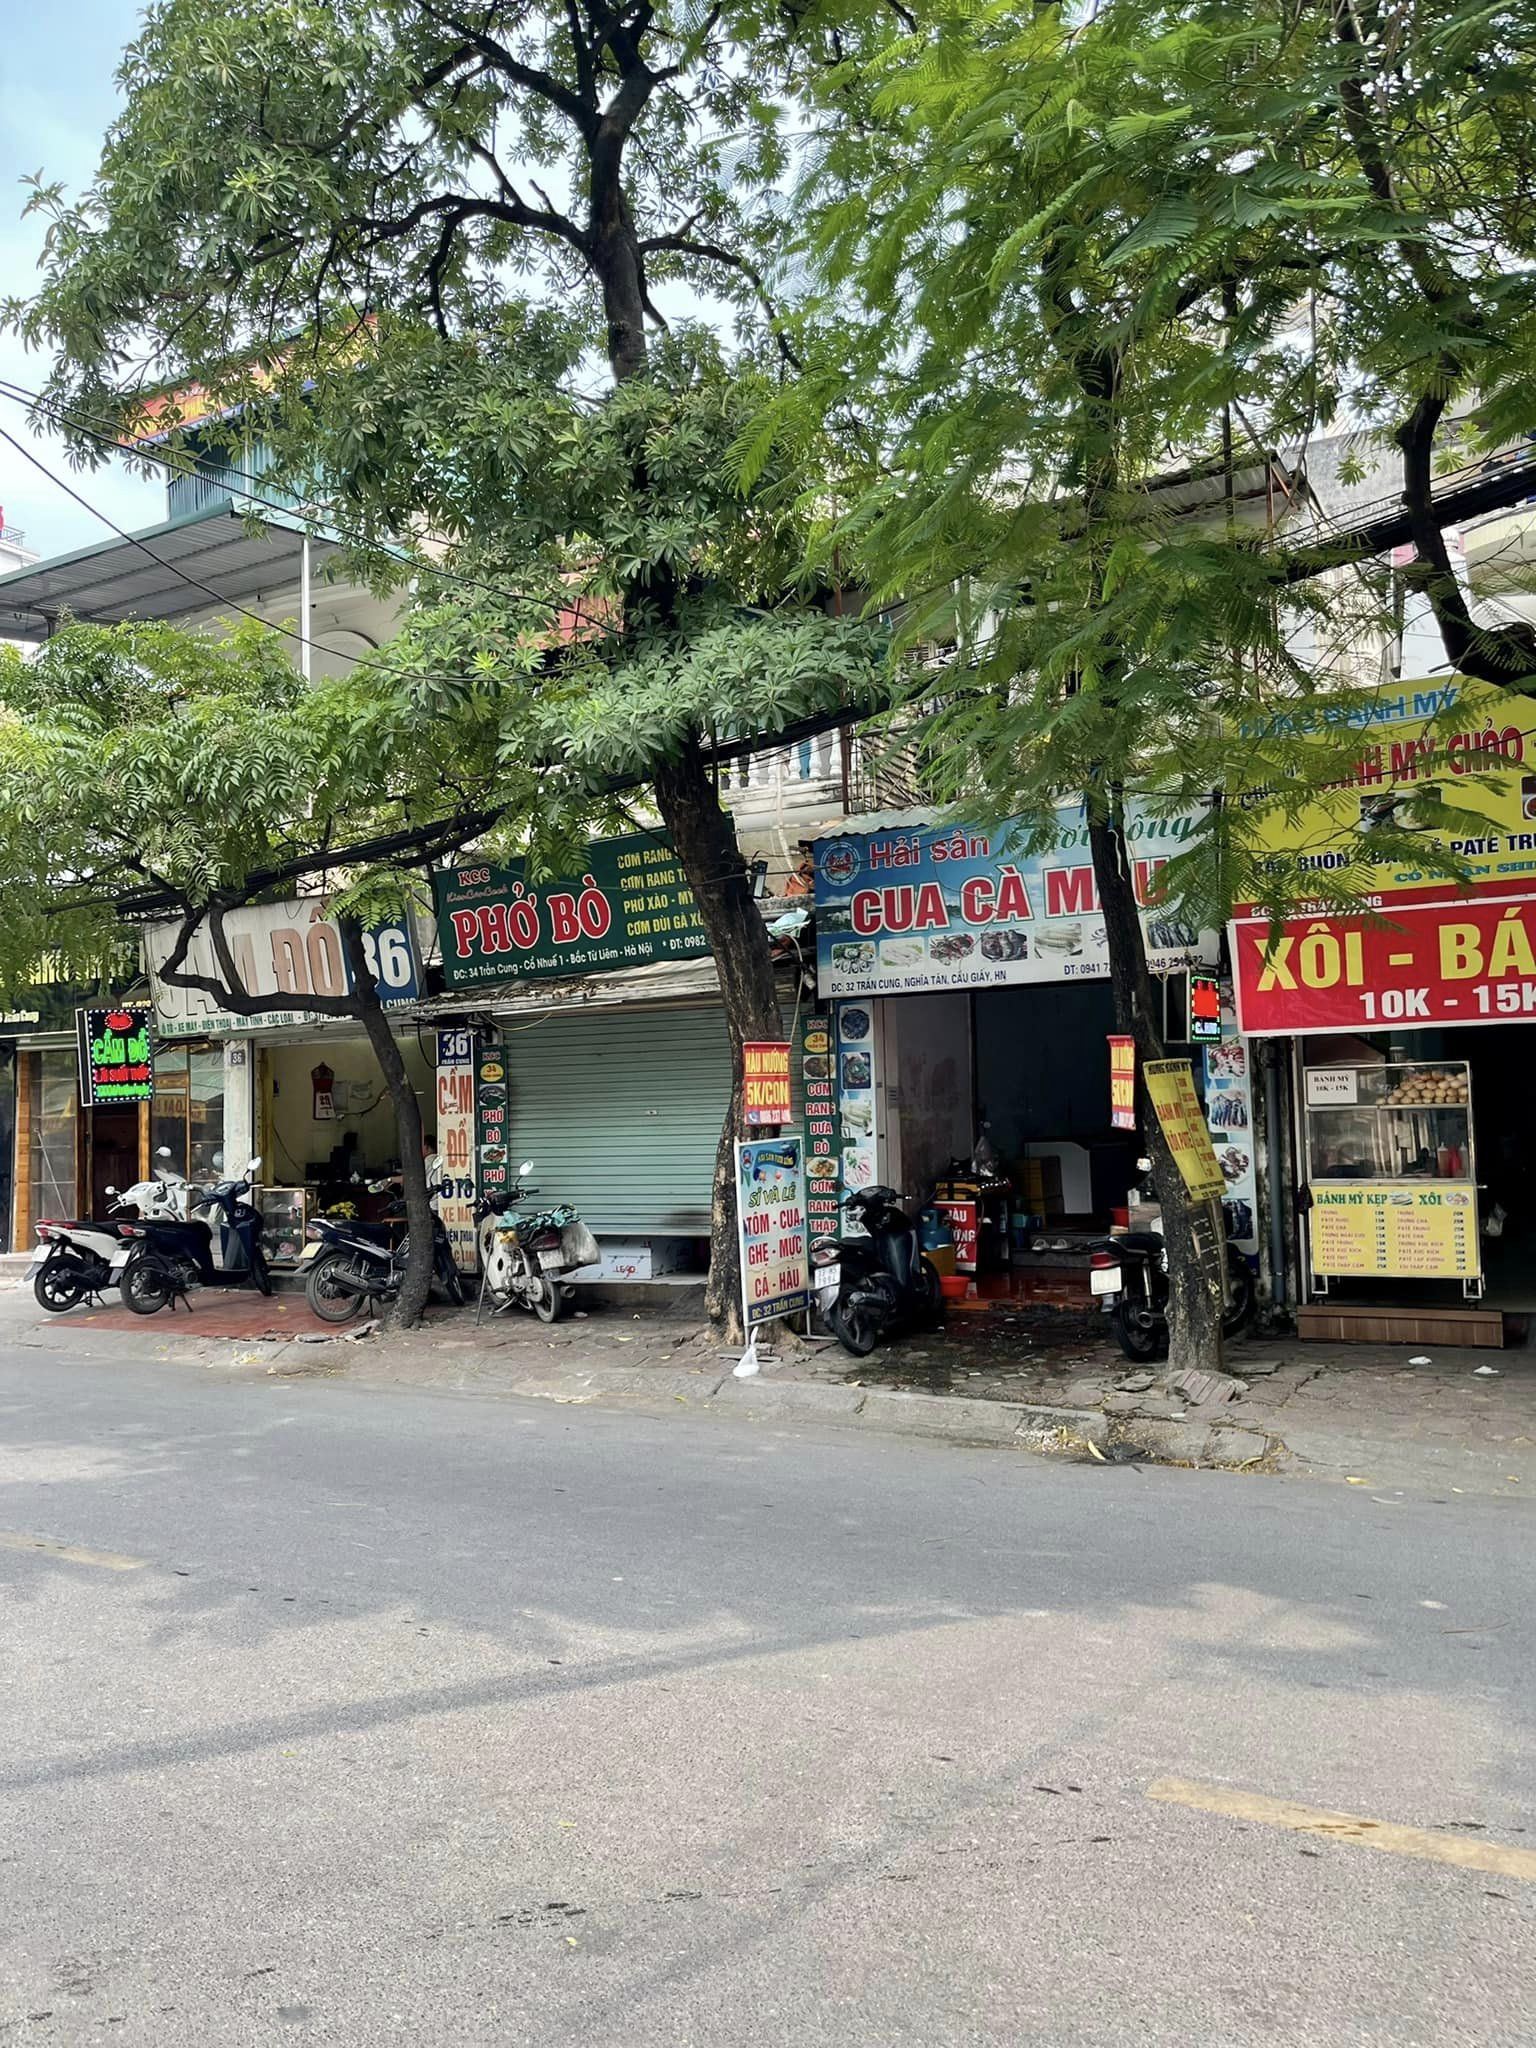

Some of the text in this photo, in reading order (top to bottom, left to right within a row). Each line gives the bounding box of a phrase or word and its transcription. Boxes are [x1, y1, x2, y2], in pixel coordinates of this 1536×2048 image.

[1322, 742, 1382, 791] NH
[1447, 716, 1525, 776] CHẢO
[643, 847, 672, 865] RANG
[870, 836, 920, 870] Hải
[930, 829, 990, 863] sản
[1450, 838, 1499, 857] PATE
[457, 867, 491, 887] KCC
[620, 875, 645, 891] CƠM
[646, 870, 675, 888] RANG
[851, 856, 1172, 937] CUA CÀ MU
[450, 873, 612, 958] PHỞ BÒ
[626, 919, 651, 936] CƠM
[673, 912, 688, 929] GÀ
[670, 938, 683, 950] ĐT:
[1253, 921, 1364, 993] XÔI
[1438, 906, 1536, 981] BÁ
[468, 968, 478, 978] 34
[497, 963, 518, 975] Cung
[559, 955, 563, 965] 1
[624, 945, 637, 957] Hà
[845, 982, 855, 991] 32
[994, 970, 1007, 980] HN
[1359, 988, 1431, 1019] 10K
[442, 1033, 469, 1057] 36
[232, 1052, 242, 1064] 36
[746, 1080, 789, 1107] 5K/CON
[807, 1082, 832, 1096] CƠM
[805, 1102, 837, 1116] RANG
[486, 1126, 501, 1143] BÒ
[813, 1138, 830, 1154] BÒ
[808, 1200, 839, 1214] RANG
[1316, 1190, 1346, 1205] BÁNH
[1418, 1191, 1442, 1206] XÔI
[442, 1206, 455, 1222] XE
[746, 1211, 770, 1236] TÔM
[780, 1208, 801, 1230] CUA
[754, 1272, 769, 1297] CÁ
[778, 1265, 800, 1292] HÀU
